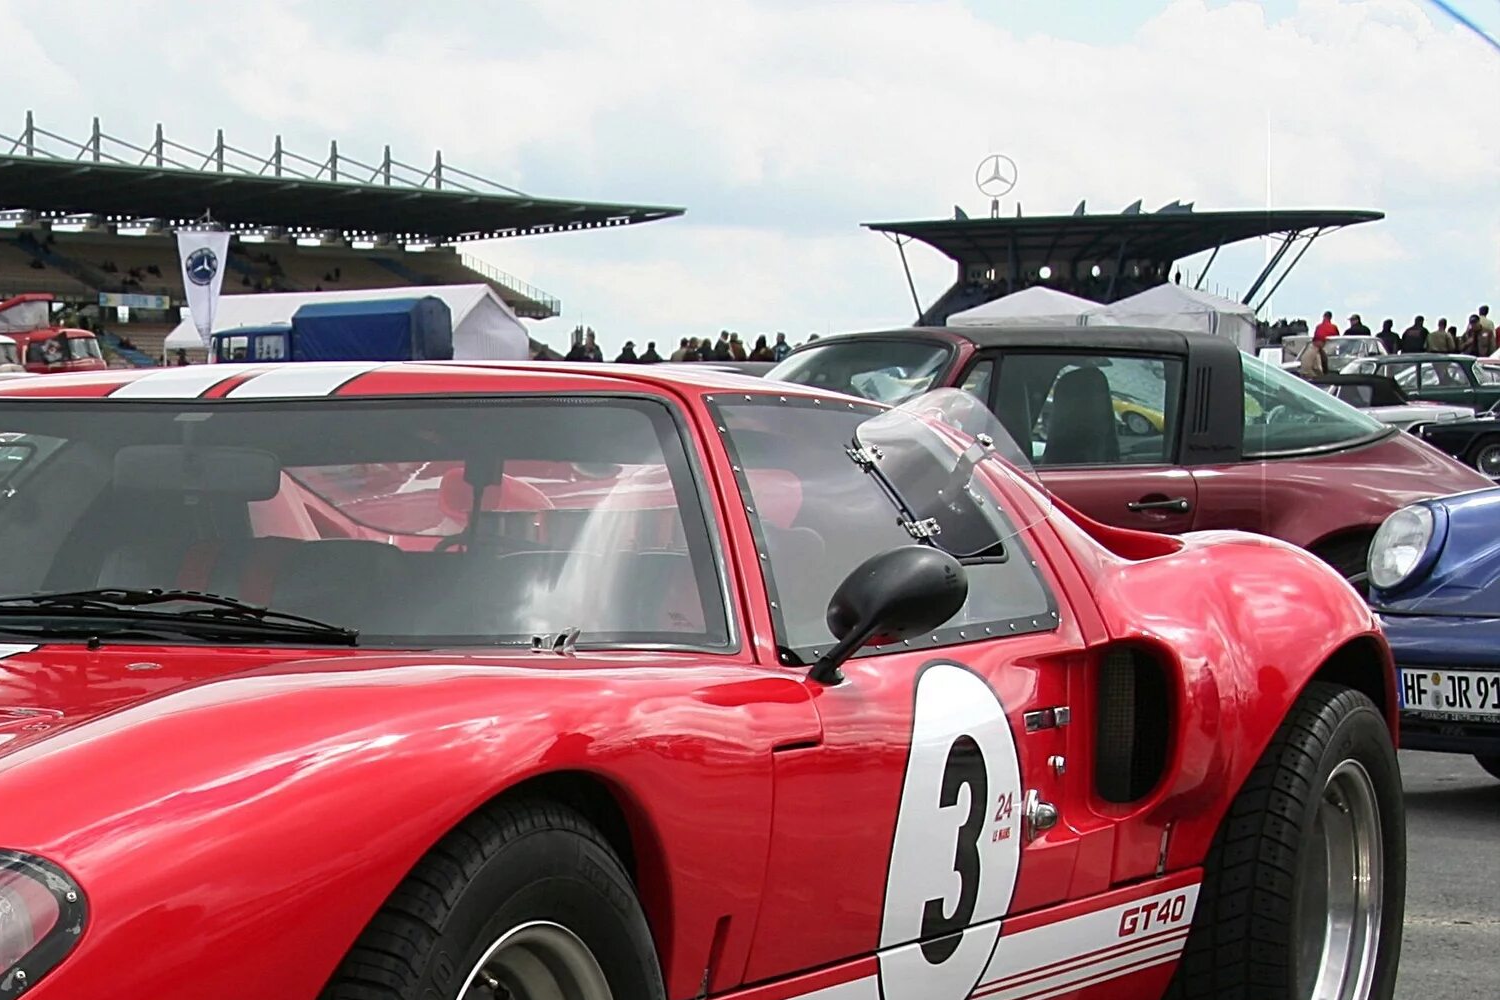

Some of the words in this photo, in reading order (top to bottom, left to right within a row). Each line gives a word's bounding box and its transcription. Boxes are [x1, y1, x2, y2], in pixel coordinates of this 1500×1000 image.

[1403, 672, 1428, 705] HF
[1445, 675, 1472, 709] JR
[995, 792, 1013, 822] 24
[920, 734, 988, 965] 3
[1119, 894, 1186, 937] GT40
